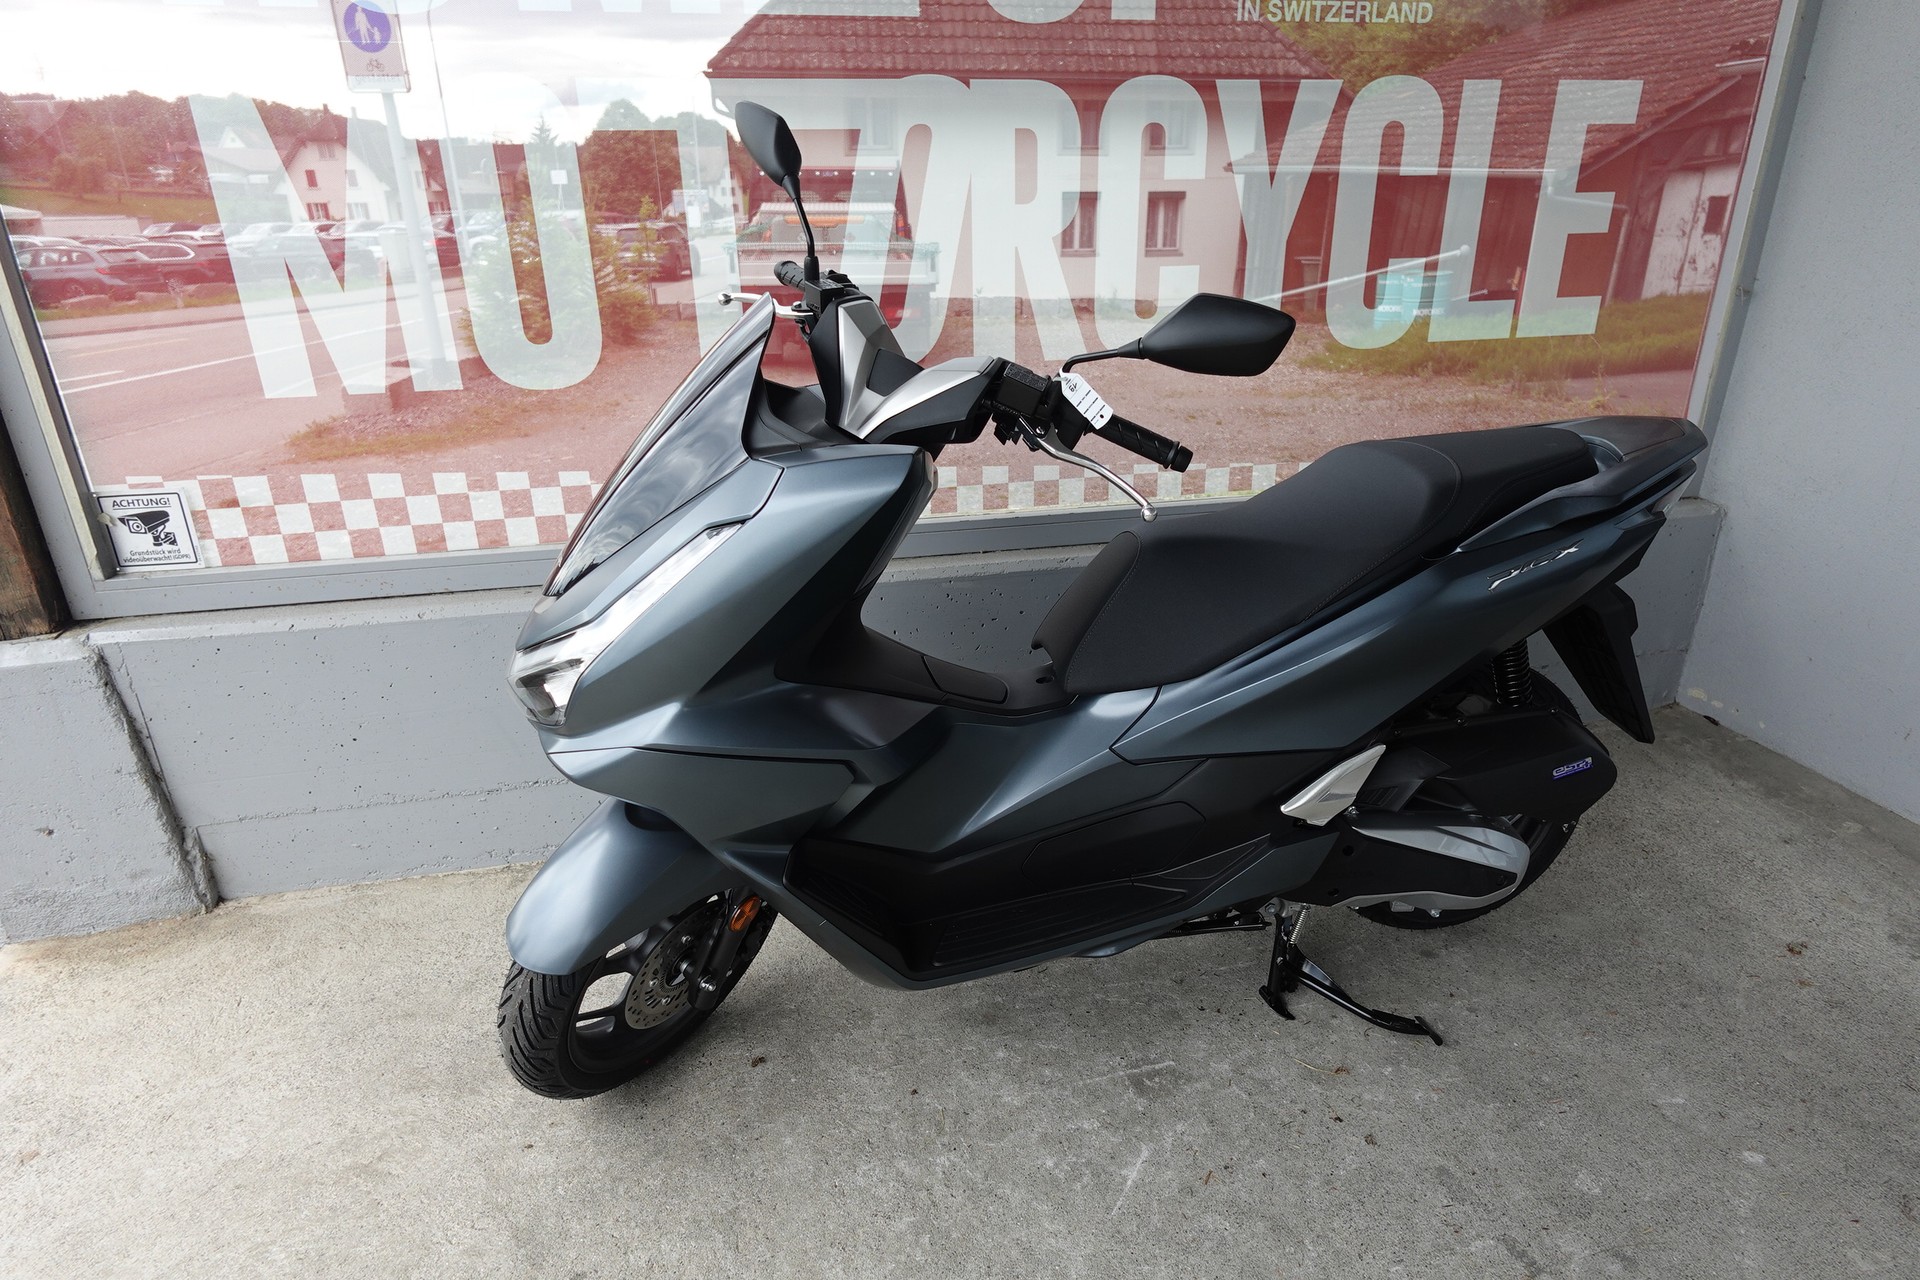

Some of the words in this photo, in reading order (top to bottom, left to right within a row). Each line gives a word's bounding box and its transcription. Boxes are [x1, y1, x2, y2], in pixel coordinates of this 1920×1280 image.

[1236, 0, 1261, 21] IN
[1267, 0, 1434, 24] SWITZERLAND
[112, 497, 171, 508] ACHTUNG!
[129, 549, 167, 557] Grundstück
